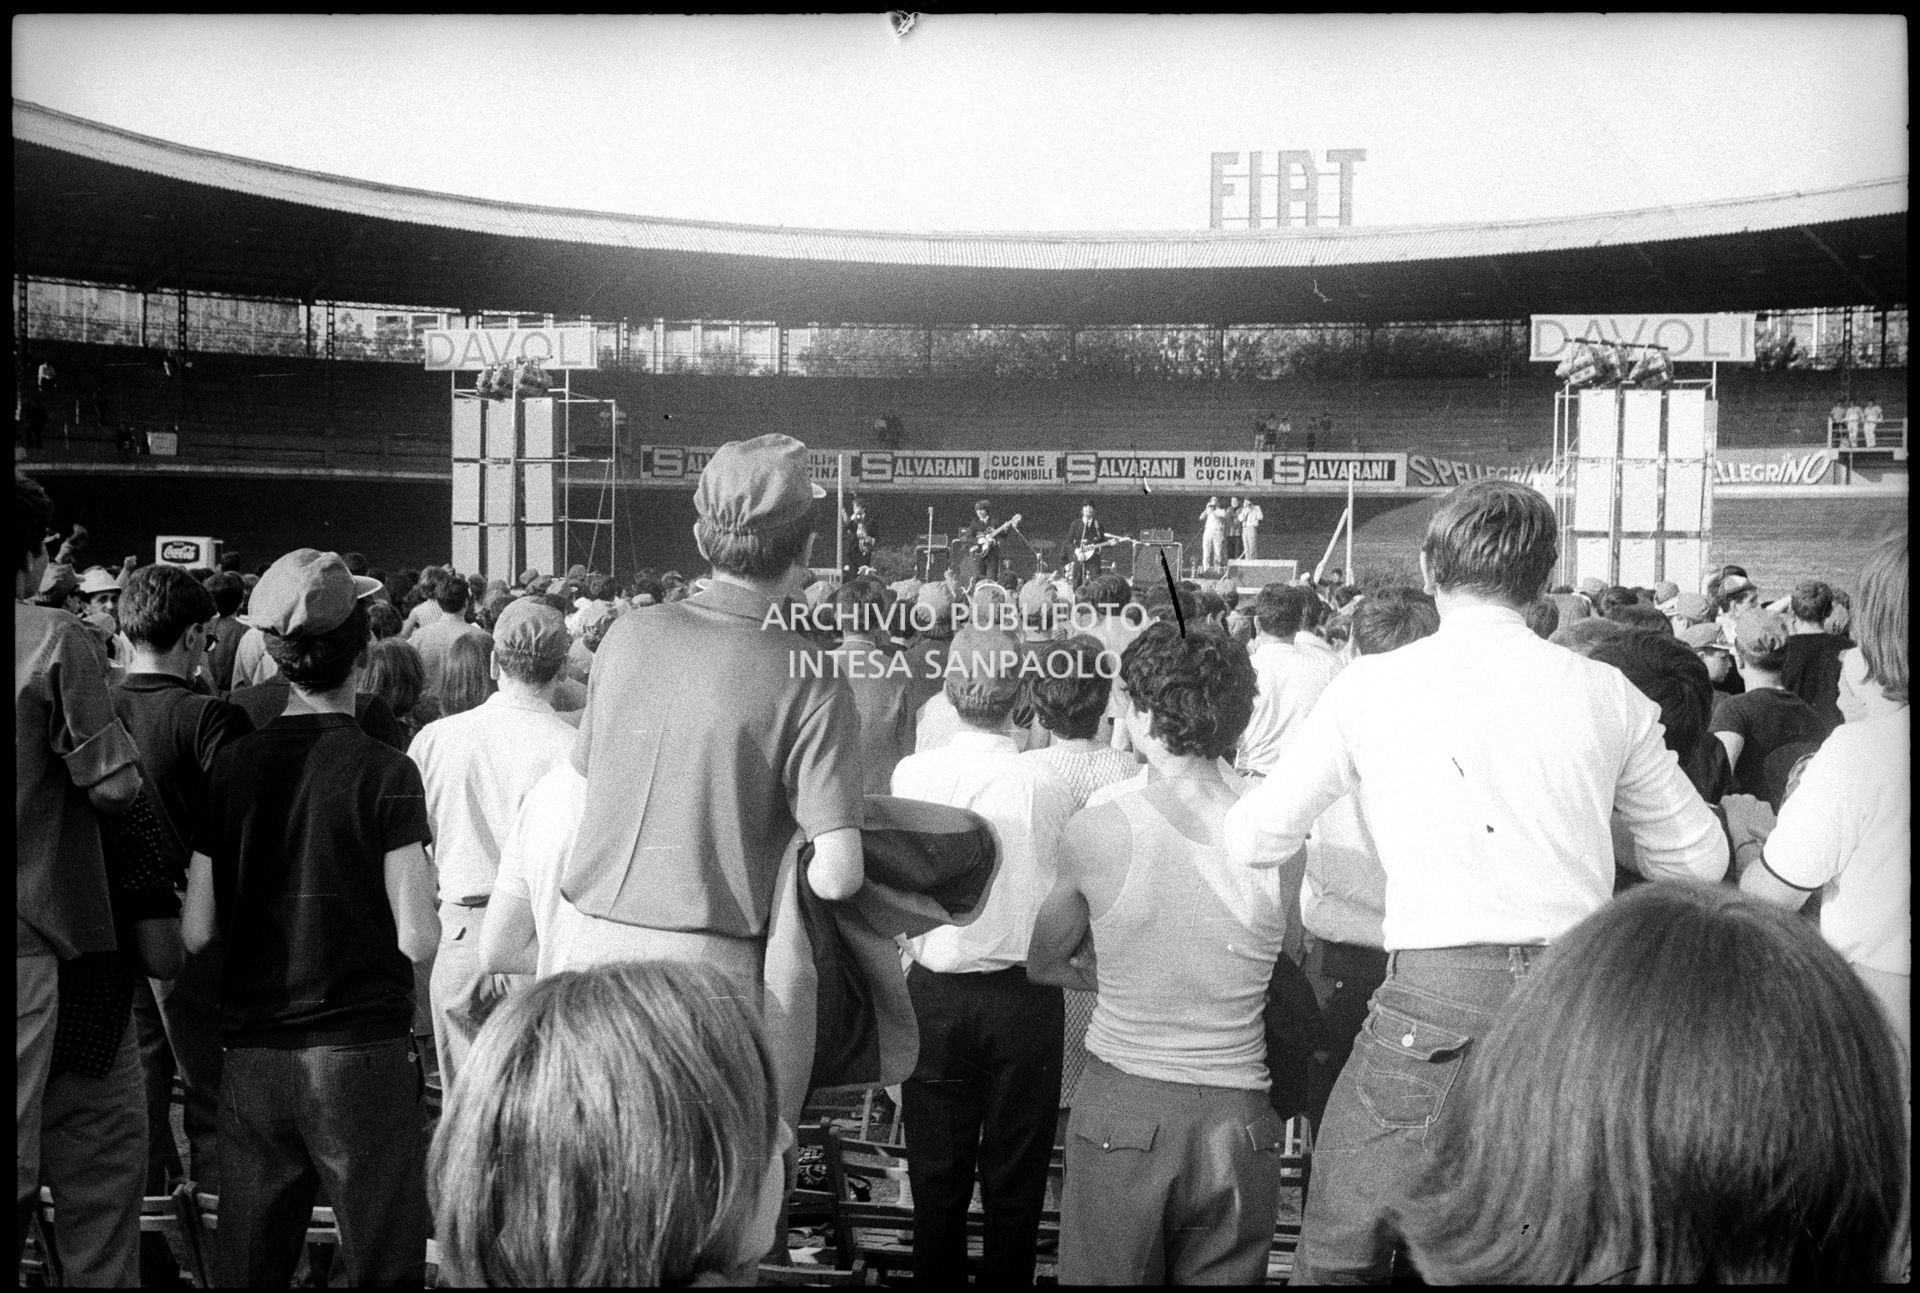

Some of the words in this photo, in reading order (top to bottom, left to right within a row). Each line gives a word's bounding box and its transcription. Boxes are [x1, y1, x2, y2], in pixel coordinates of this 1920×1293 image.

[1210, 148, 1367, 229] FIAT
[427, 331, 595, 367] DAVOLI
[1535, 318, 1747, 358] DAVOLI
[861, 453, 973, 482] SALVARANI
[983, 468, 1053, 481] COMPONIBILI
[991, 455, 1046, 467] CUCINE
[1067, 454, 1179, 483] SALVARANI
[1193, 456, 1238, 468] MOBILI
[1240, 458, 1256, 468] PER
[1195, 469, 1253, 482] CUCINA
[1273, 455, 1389, 484] SALVARANI
